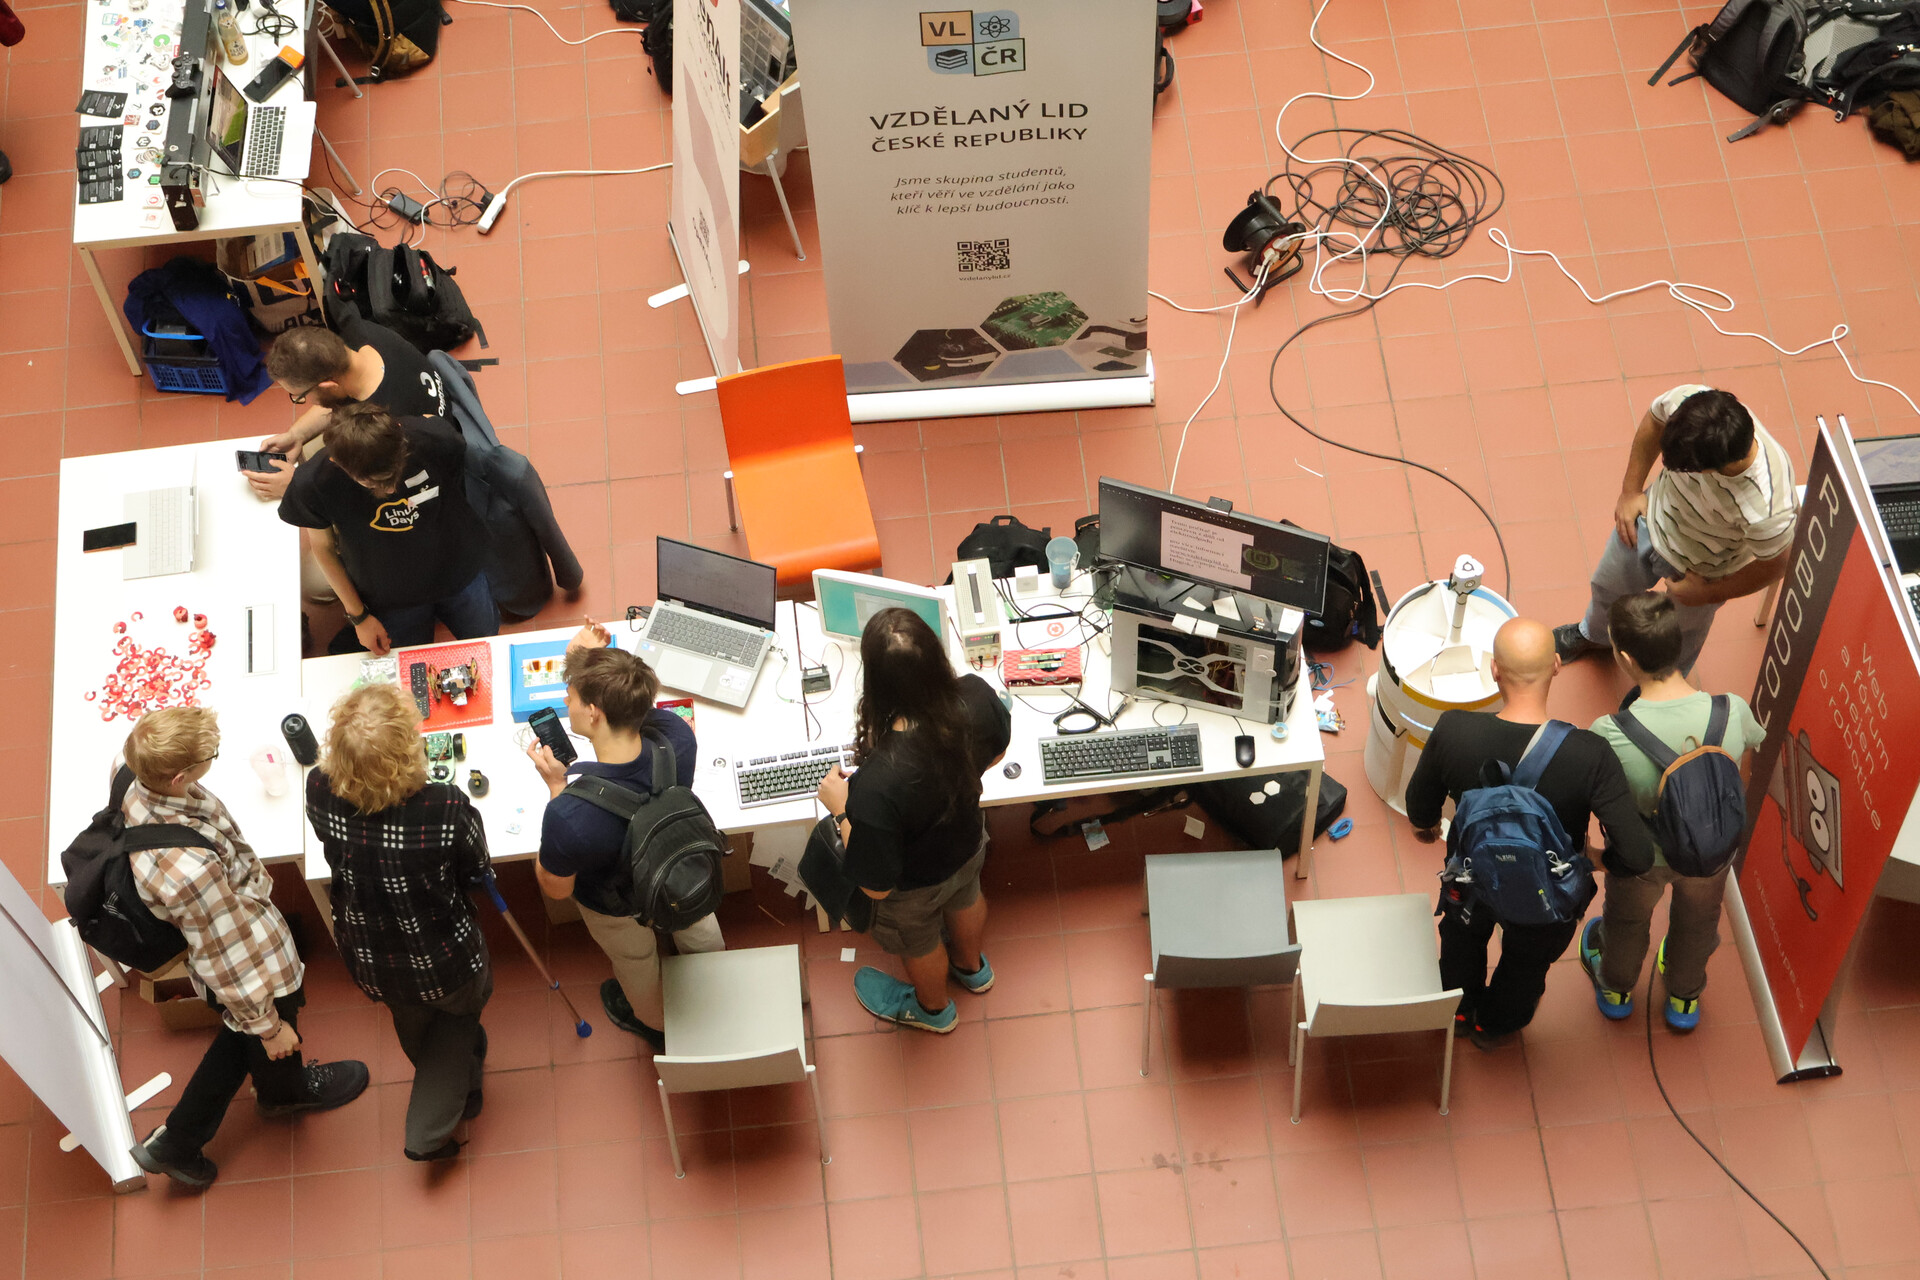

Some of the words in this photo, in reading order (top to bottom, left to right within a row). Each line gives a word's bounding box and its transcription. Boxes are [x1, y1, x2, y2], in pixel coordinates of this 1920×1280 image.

[928, 21, 966, 37] VL
[981, 46, 1017, 66] ČR
[869, 99, 1031, 130] VZDĚLANÝ
[1042, 103, 1089, 118] LID
[872, 132, 945, 153] ČESKÉ
[955, 127, 1088, 148] REPUBLIKY
[894, 177, 931, 189] Jsme
[935, 174, 994, 185] skupina
[998, 166, 1067, 180] studentů,
[890, 190, 923, 201] kteří
[928, 189, 955, 199] věří
[959, 191, 975, 199] ve
[980, 181, 1041, 197] vzdělání
[1041, 181, 1075, 192] jako
[897, 204, 921, 215] klíč
[925, 205, 933, 213] k
[937, 203, 972, 215] lepší
[976, 195, 1070, 212] budoucnosti.
[389, 510, 420, 527] Days
[1862, 642, 1888, 720] Web
[1841, 645, 1850, 668] a
[1853, 669, 1889, 770] fórum
[1839, 682, 1875, 774] nejen
[1819, 668, 1828, 690] o
[1828, 695, 1882, 831] robotice
